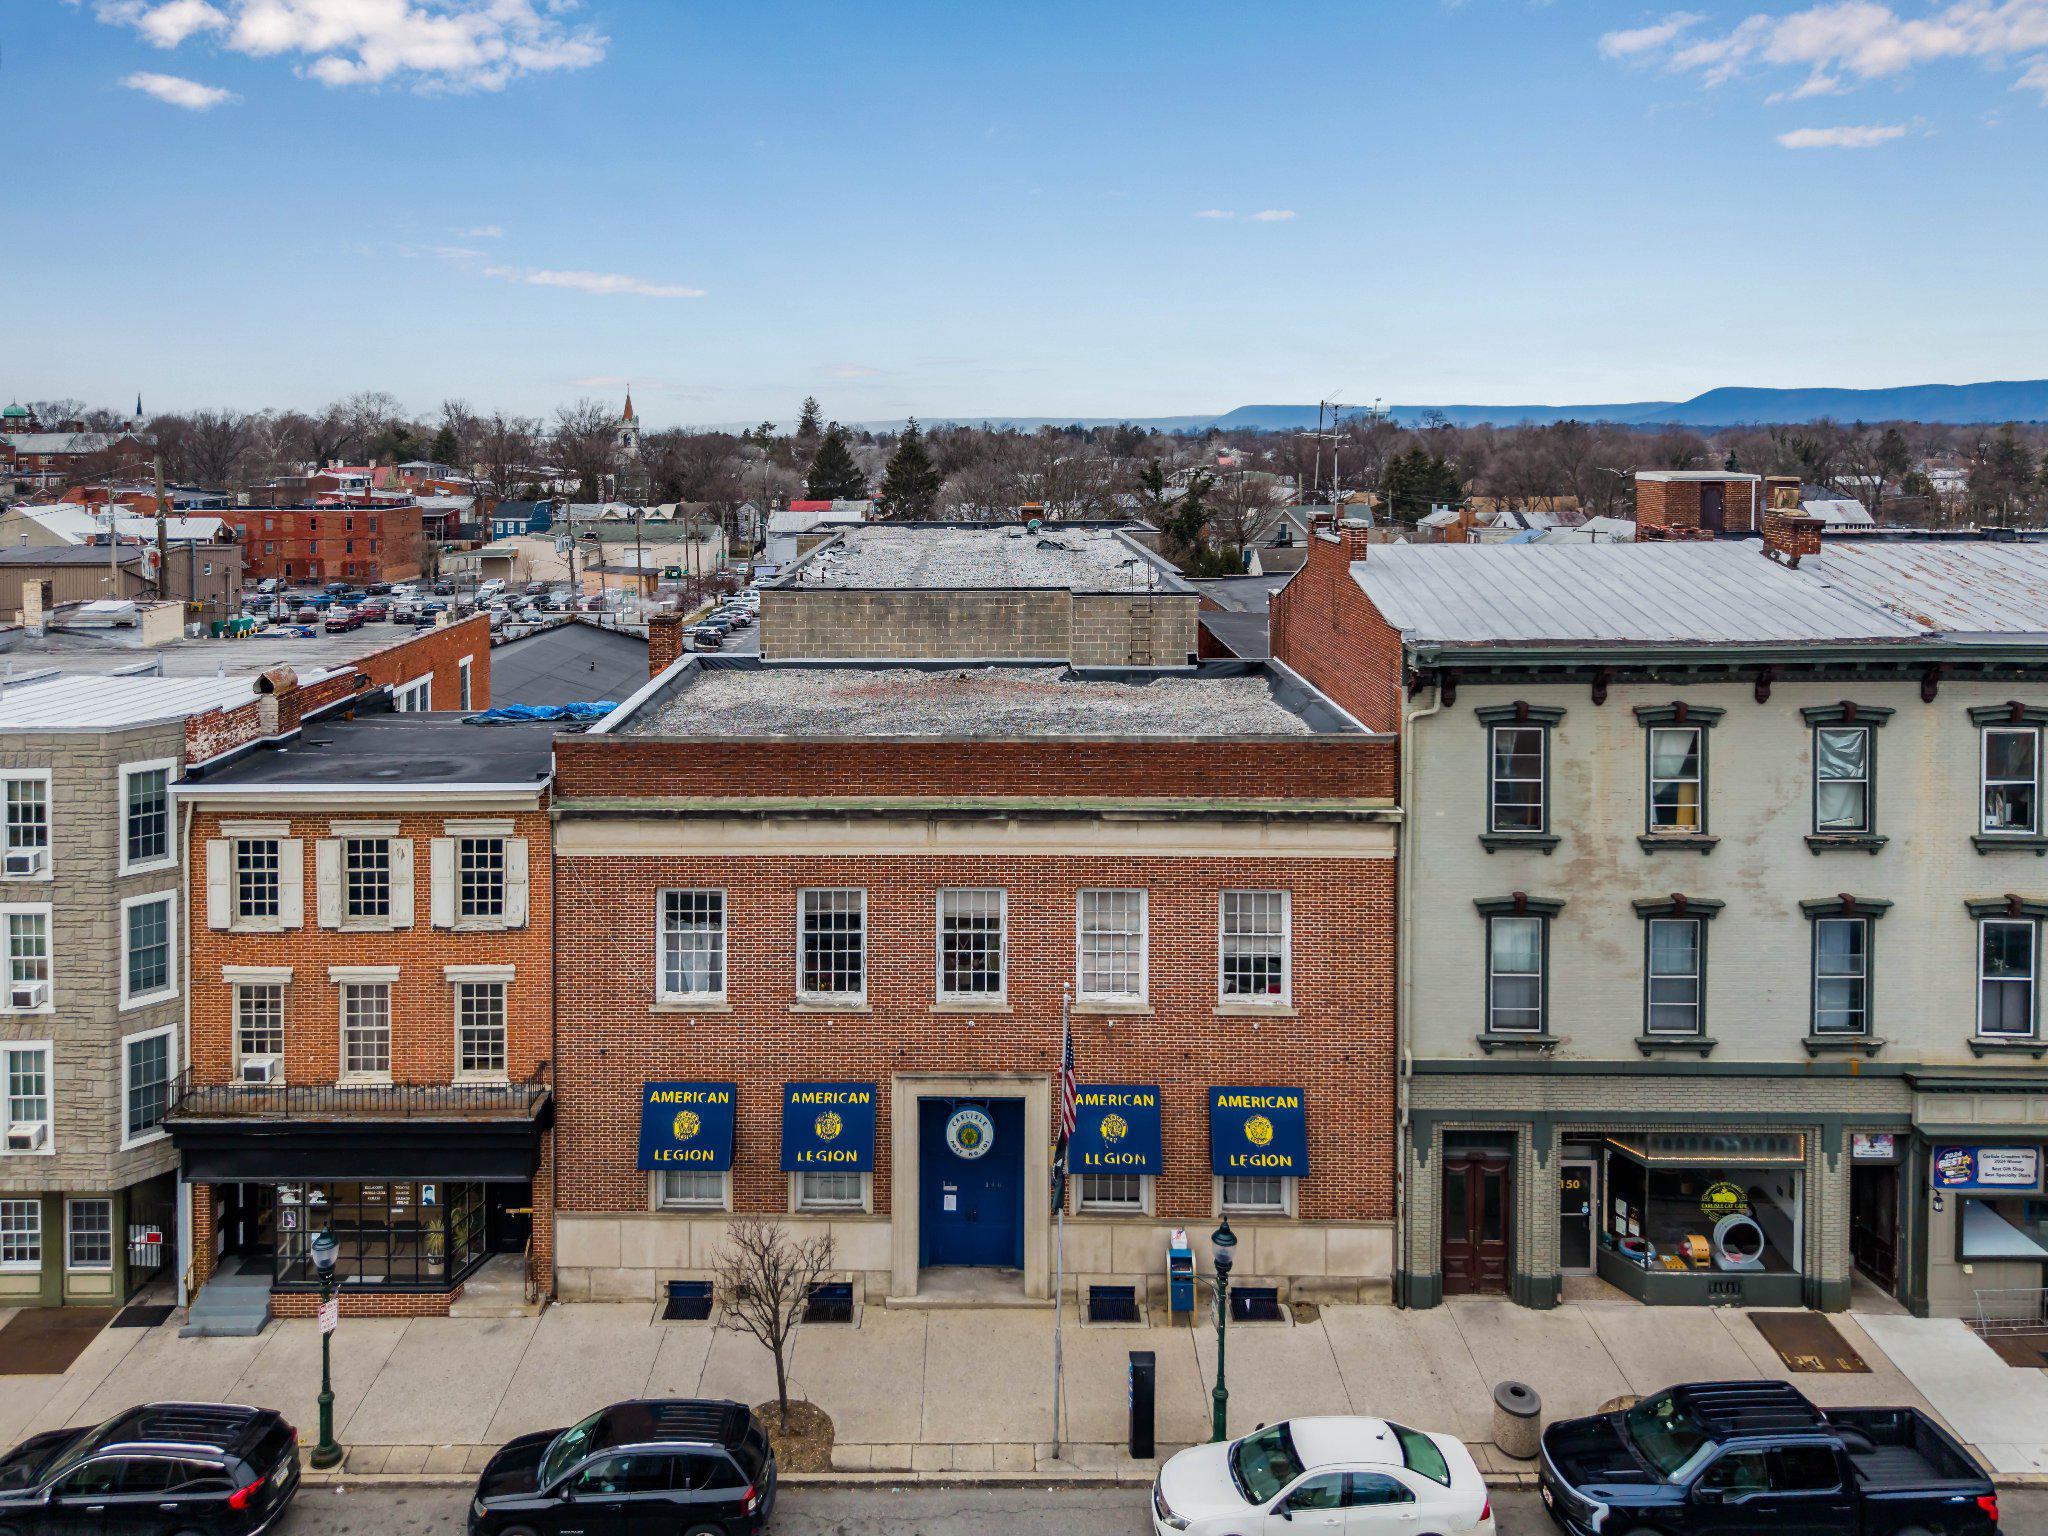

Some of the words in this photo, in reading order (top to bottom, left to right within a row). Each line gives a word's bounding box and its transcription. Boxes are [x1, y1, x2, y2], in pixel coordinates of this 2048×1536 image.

[650, 1090, 729, 1104] AMERICAN
[791, 1092, 870, 1104] AMERICAN
[1075, 1093, 1155, 1107] AMERICAN
[1217, 1094, 1299, 1109] AMERICAN
[952, 1113, 988, 1127] CARLISLE
[950, 1140, 963, 1154] POST
[654, 1149, 714, 1162] LEGION
[797, 1150, 858, 1163] LEGION
[1230, 1154, 1292, 1168] LEGION
[1944, 1151, 1963, 1160] 2024
[1938, 1156, 1963, 1169] BEST
[1560, 1180, 1580, 1189] 150
